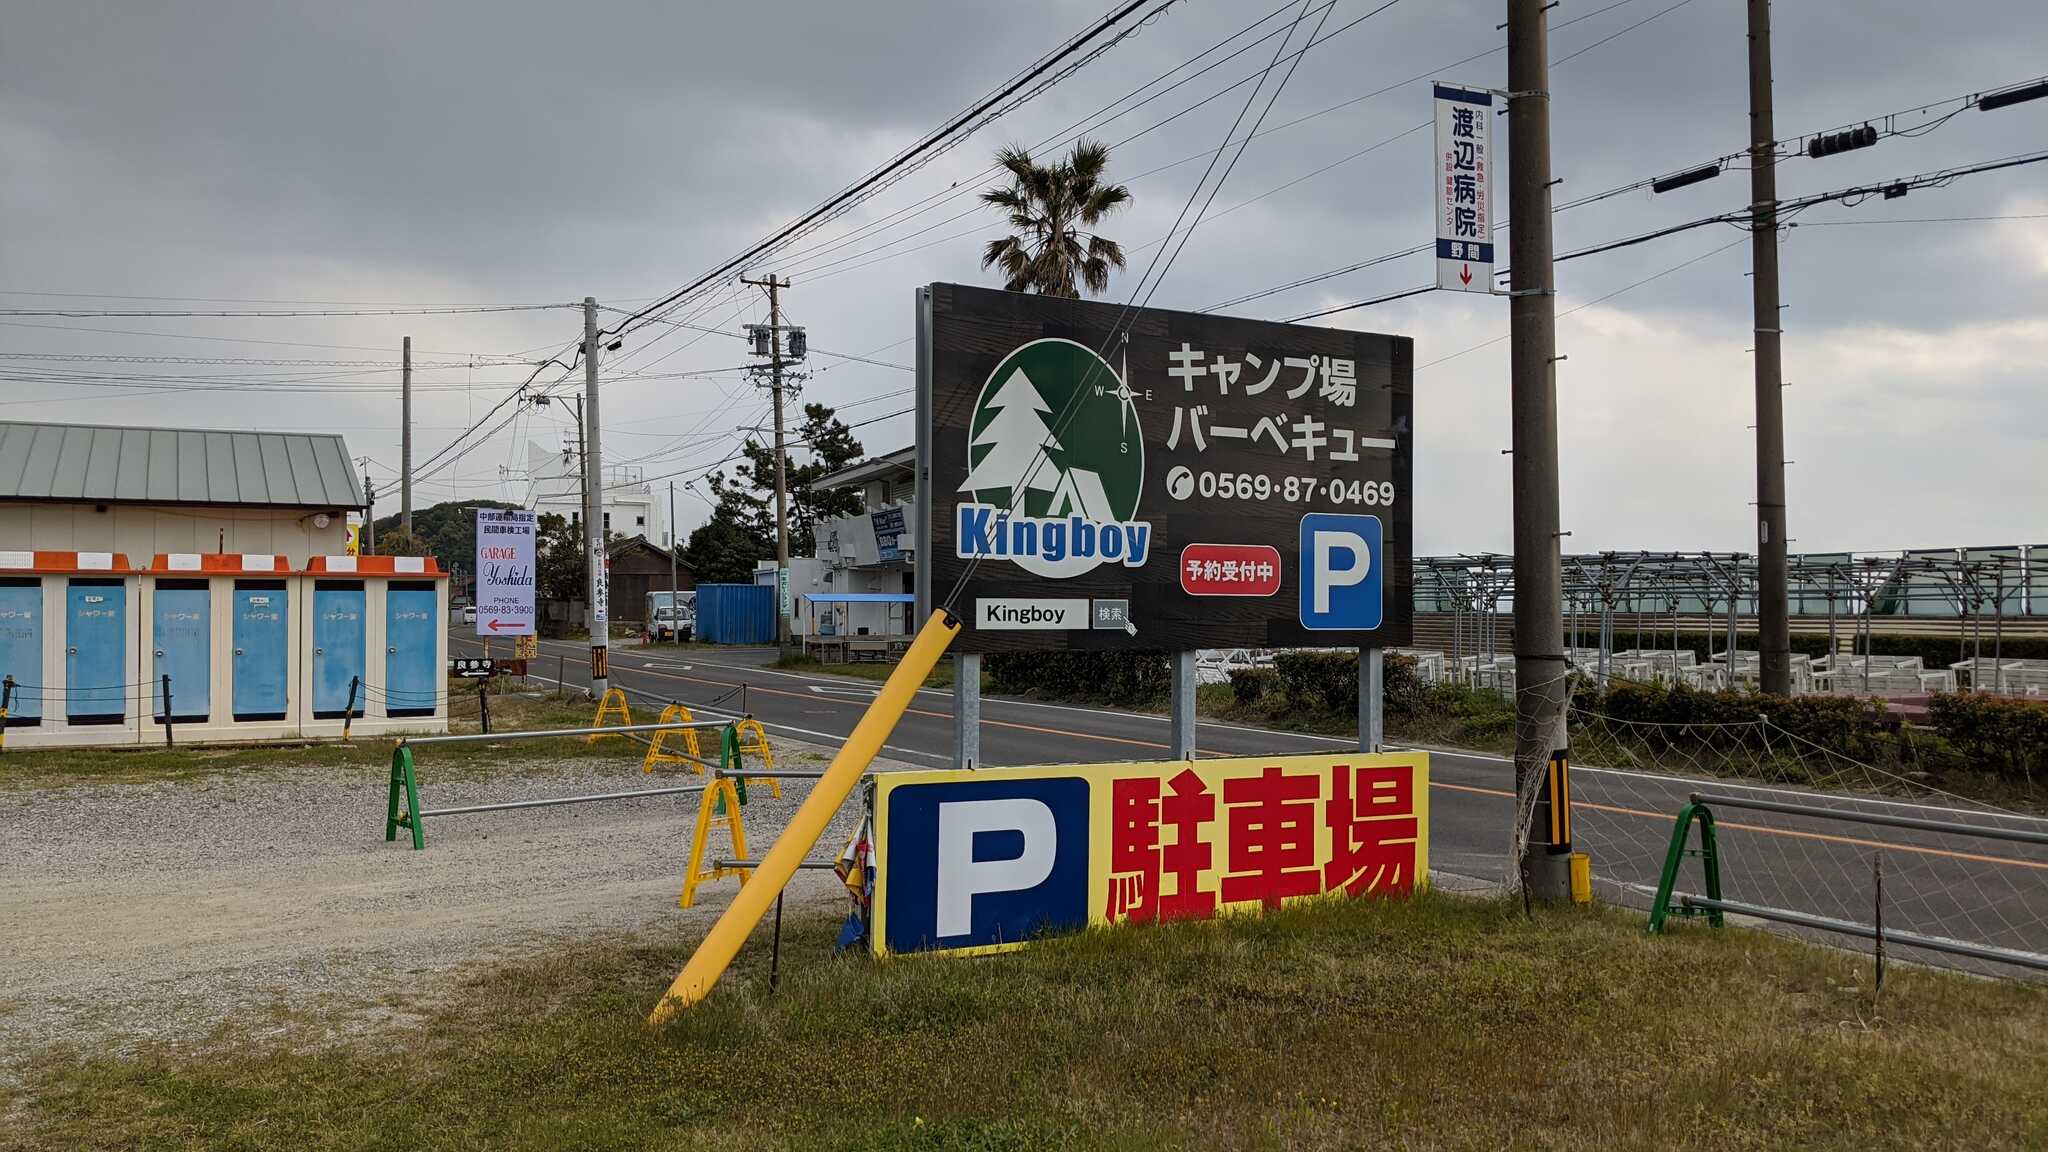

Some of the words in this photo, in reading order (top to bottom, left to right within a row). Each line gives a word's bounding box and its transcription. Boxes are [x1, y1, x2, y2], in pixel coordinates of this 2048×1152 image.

[1452, 106, 1477, 238] 渡辺病院
[1451, 242, 1480, 260] 野間
[1121, 332, 1129, 343] N
[1168, 342, 1357, 407] キャンプ場
[1094, 385, 1105, 397] W
[1145, 390, 1153, 401] E
[1166, 405, 1396, 461] バーベキュー
[1120, 442, 1128, 453] S
[961, 507, 1149, 563] Kingboy
[480, 547, 517, 560] GARAGE
[483, 561, 533, 586] Yoshida
[1186, 560, 1274, 582] 予約受付中
[1314, 531, 1371, 613] P
[493, 597, 520, 605] PHONE
[987, 605, 1066, 623] Kingboy
[1098, 608, 1122, 621] 検索
[936, 799, 1057, 938] P
[1104, 765, 1418, 925] 駐車場
